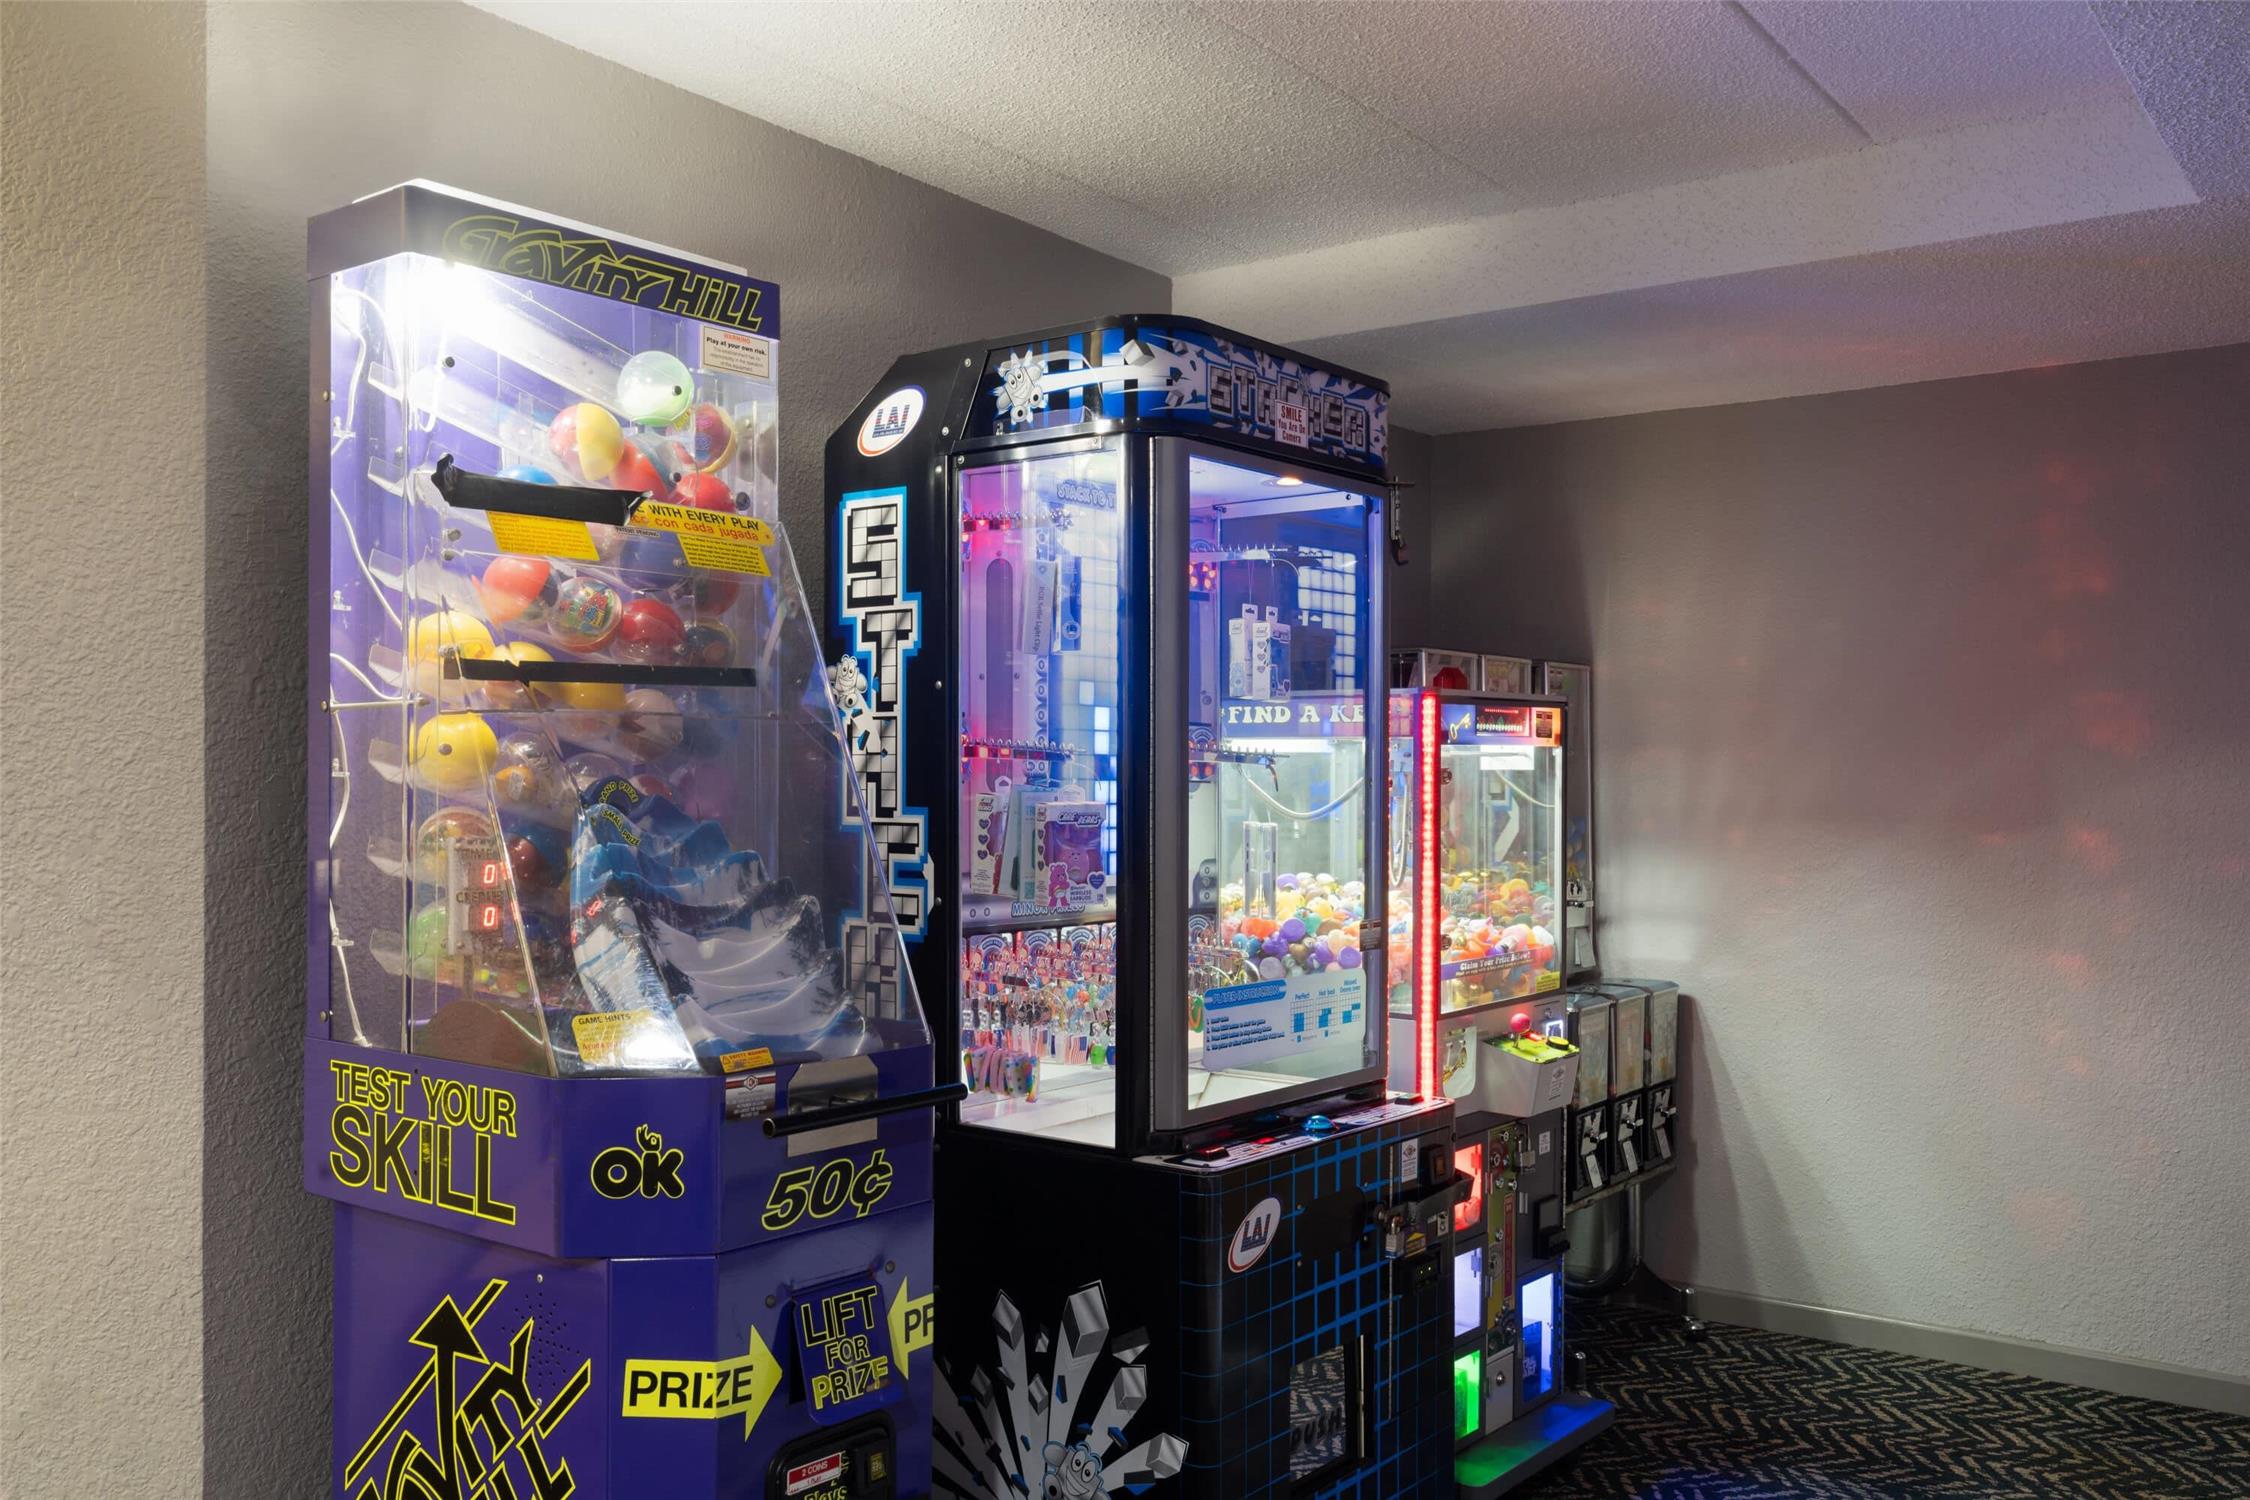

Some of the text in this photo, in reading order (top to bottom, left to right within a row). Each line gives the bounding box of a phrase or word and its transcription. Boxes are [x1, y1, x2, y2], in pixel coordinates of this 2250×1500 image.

[706, 337, 719, 346] Play
[873, 404, 910, 430] LAI
[1277, 418, 1288, 430] You
[1288, 420, 1298, 433] Are
[1280, 405, 1303, 423] SMILE
[1281, 430, 1302, 444] Camera
[648, 504, 683, 519] WITH
[686, 509, 726, 526] EVERY
[730, 517, 760, 532] PLAY
[655, 516, 679, 529] con
[683, 519, 714, 534] cada
[719, 525, 760, 543] jugada
[1227, 705, 1292, 724] FIND
[1299, 704, 1321, 723] A
[482, 864, 496, 884] 0
[482, 906, 496, 927] 0
[1460, 961, 1478, 972] Claim
[1479, 958, 1494, 968] Your
[1495, 955, 1510, 966] Prize
[578, 1013, 632, 1026] GAME HINTS
[329, 1058, 518, 1138] TEST YOUR
[329, 1102, 517, 1226] SKILL
[590, 1146, 685, 1199] OK
[761, 1148, 894, 1231] 50¢
[1241, 1213, 1272, 1244] LAI
[800, 1284, 878, 1348] LIFT
[824, 1333, 871, 1370] FOR
[628, 1364, 755, 1409] PRIZE
[811, 1355, 889, 1411] PRIZE
[801, 1460, 828, 1477] 2 COINS
